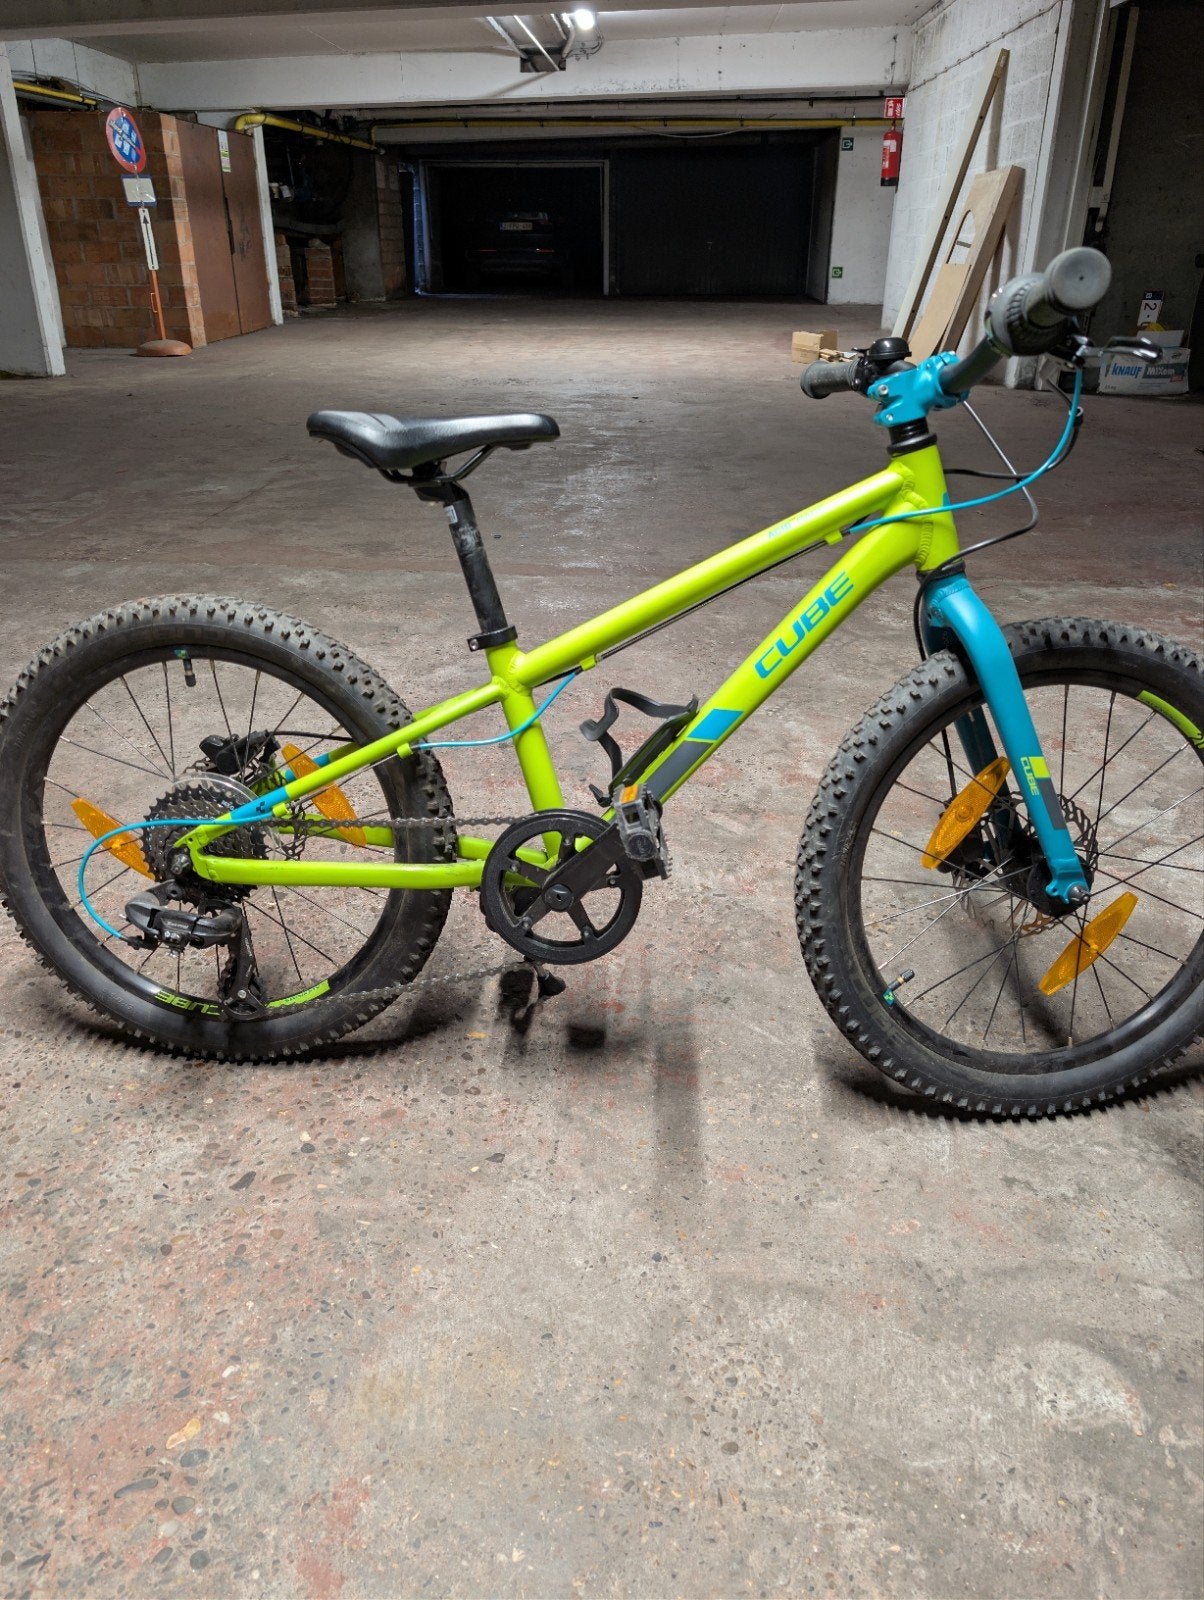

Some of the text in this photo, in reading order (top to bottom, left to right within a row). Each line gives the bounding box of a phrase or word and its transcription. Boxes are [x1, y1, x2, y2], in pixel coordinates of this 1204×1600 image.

[1111, 363, 1143, 379] KNAUF
[755, 571, 854, 679] CUBE
[1020, 756, 1041, 796] CUBE
